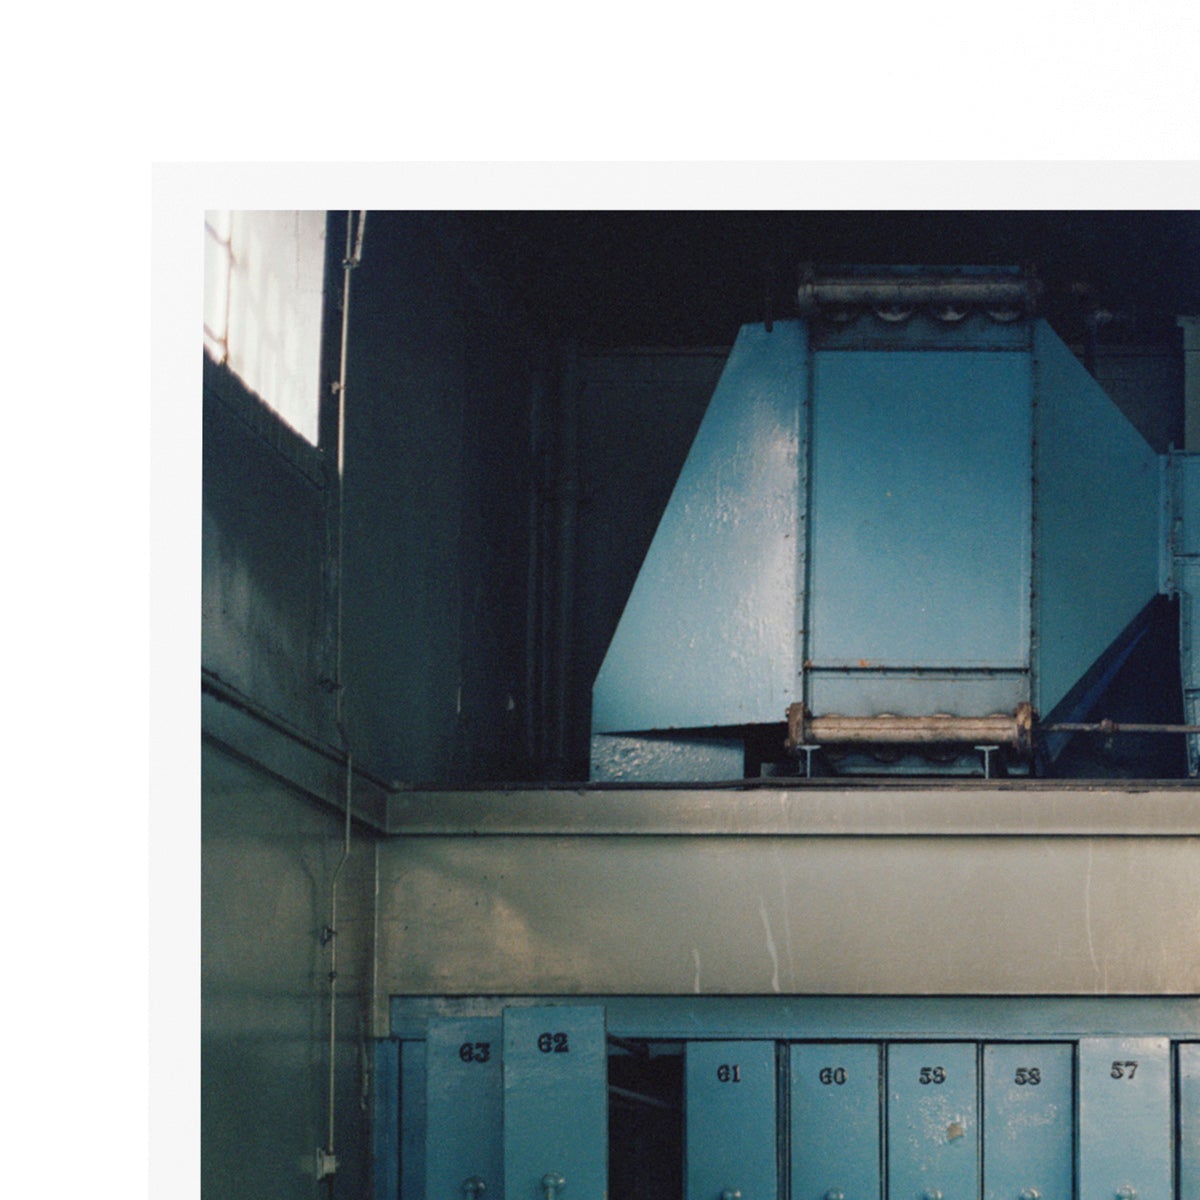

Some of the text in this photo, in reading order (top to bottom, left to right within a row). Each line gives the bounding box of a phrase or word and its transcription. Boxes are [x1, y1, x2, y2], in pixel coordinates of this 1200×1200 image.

[458, 1042, 491, 1064] 63
[537, 1032, 570, 1054] 62
[716, 1063, 741, 1083] 61
[818, 1067, 847, 1086] 60
[918, 1066, 946, 1086] 59
[1014, 1067, 1042, 1086] 58
[1109, 1060, 1138, 1080] 57
